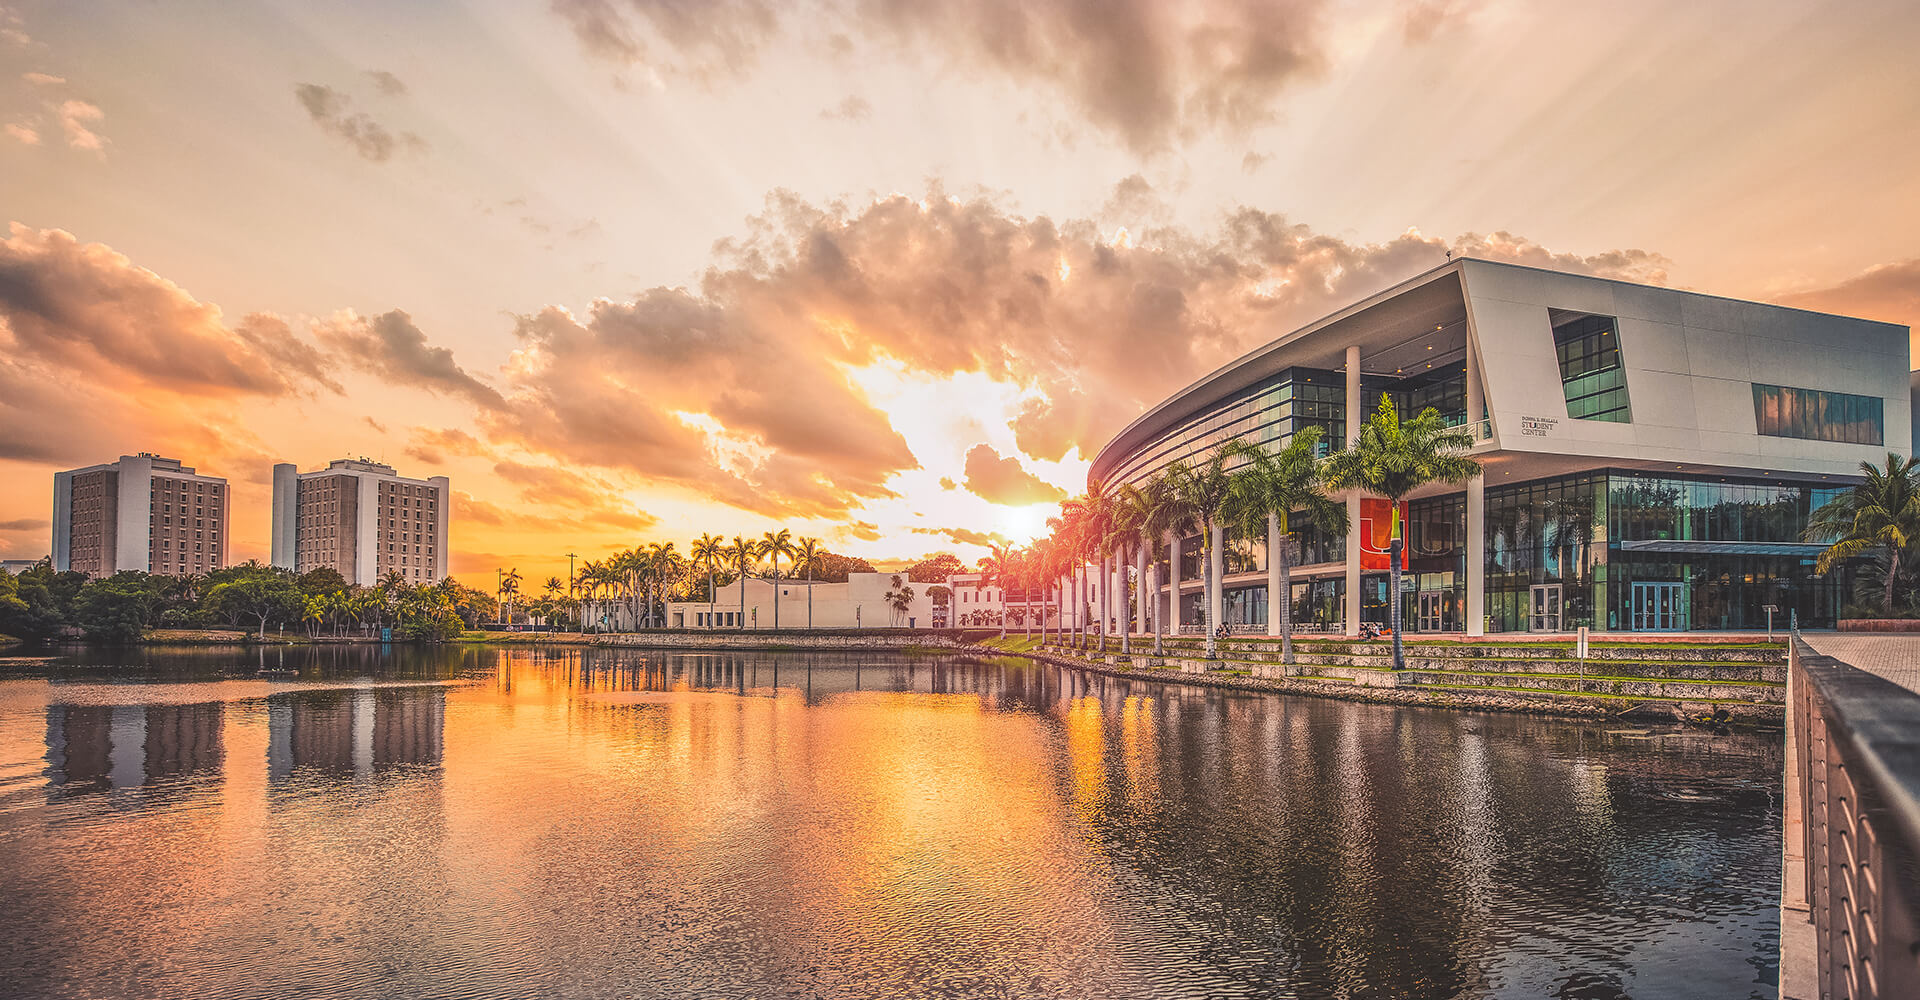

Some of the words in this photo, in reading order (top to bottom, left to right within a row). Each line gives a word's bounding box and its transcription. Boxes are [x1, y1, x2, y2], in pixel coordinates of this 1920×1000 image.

[1521, 421, 1554, 430] STUDENT
[1521, 429, 1547, 437] CENTER
[1360, 517, 1406, 555] U
